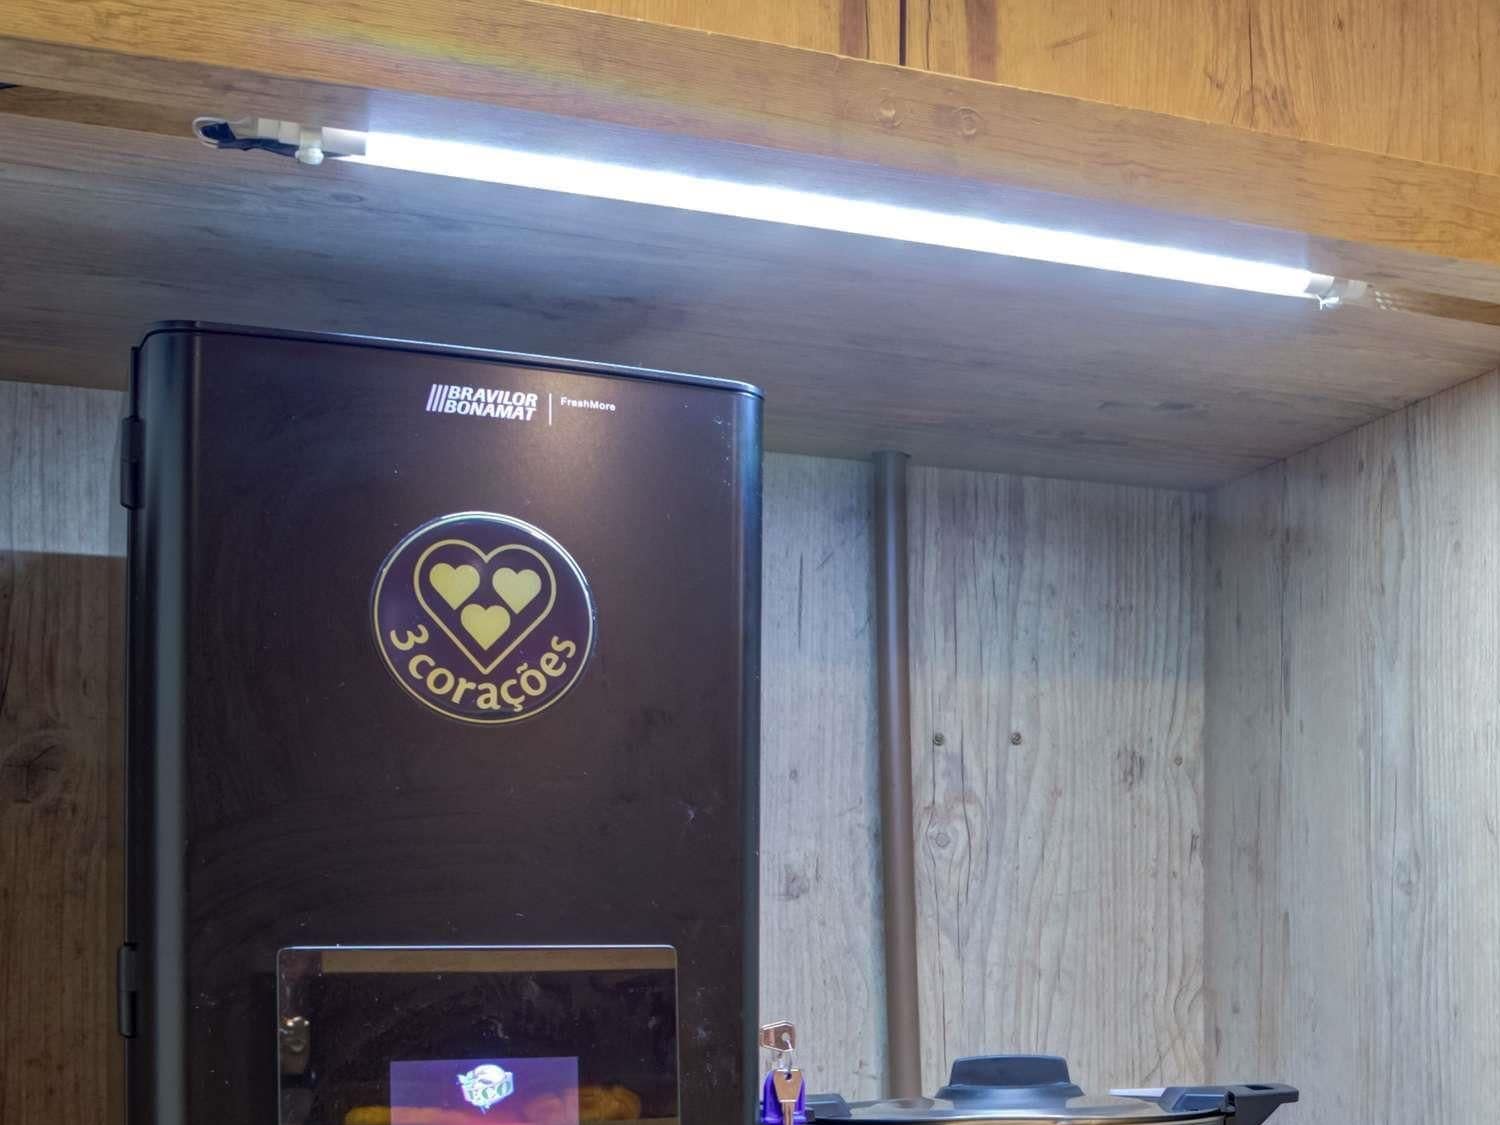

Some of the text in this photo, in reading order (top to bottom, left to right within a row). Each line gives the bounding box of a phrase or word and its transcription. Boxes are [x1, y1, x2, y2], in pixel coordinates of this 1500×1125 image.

[447, 385, 538, 408] BRAVILOR
[560, 396, 616, 413] FreshMore
[444, 400, 537, 421] BONAMAT
[390, 624, 577, 713] 3 corações
